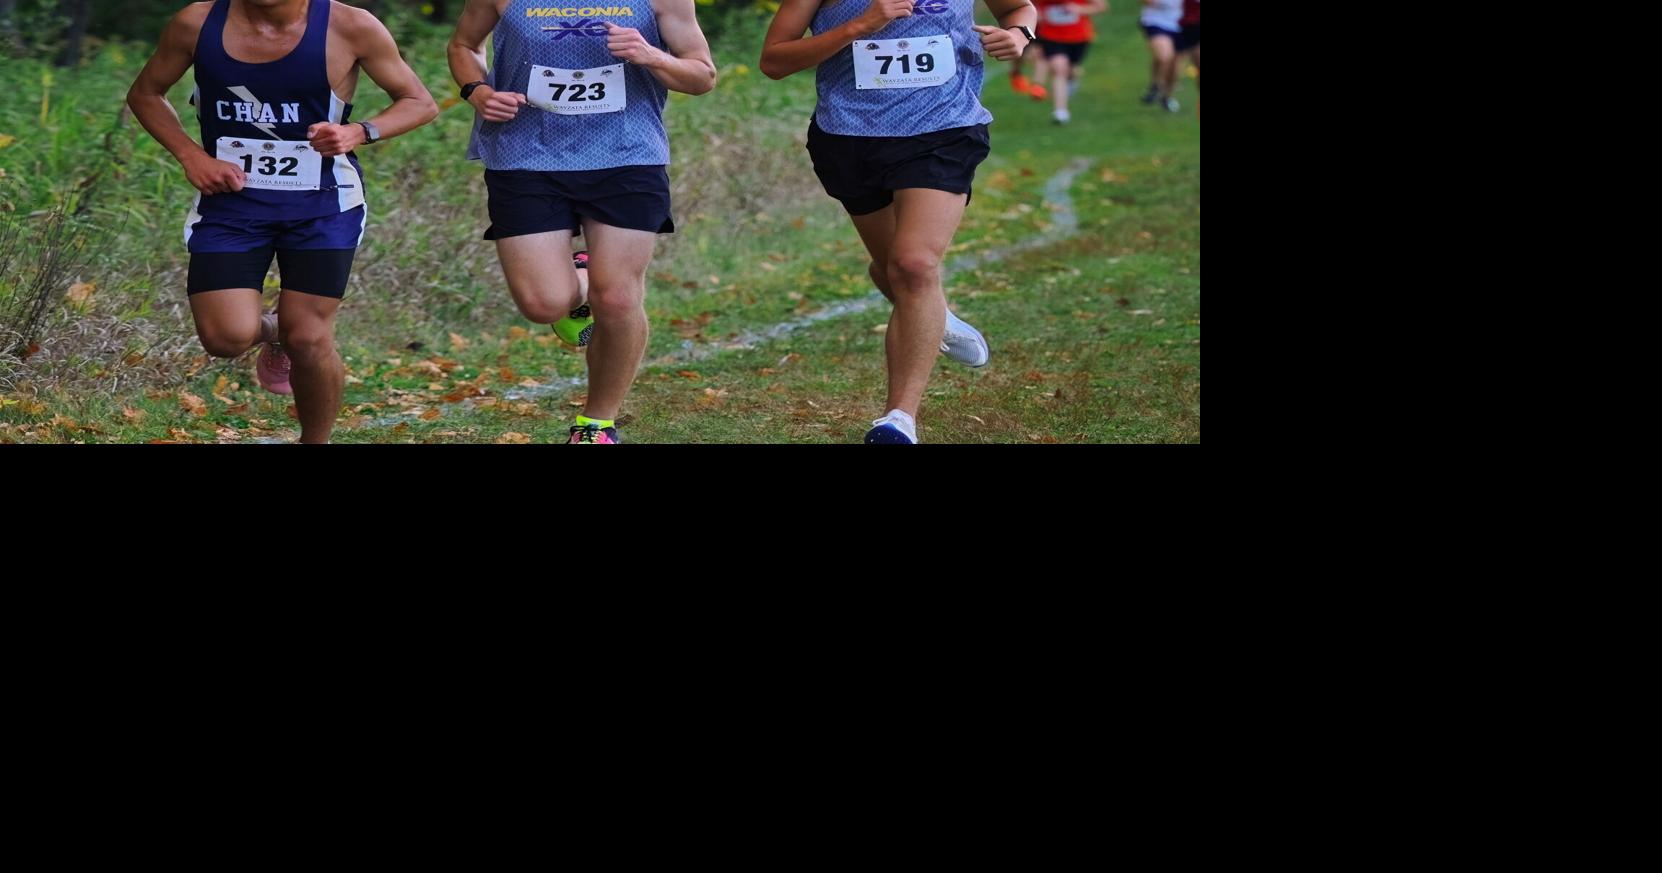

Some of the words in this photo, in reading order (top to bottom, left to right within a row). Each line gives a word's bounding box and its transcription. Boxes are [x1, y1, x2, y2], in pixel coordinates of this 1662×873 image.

[526, 6, 634, 17] WACONIA
[874, 53, 935, 75] 719
[548, 82, 606, 102] 723
[216, 100, 300, 123] CHAN
[240, 154, 299, 177] 132
